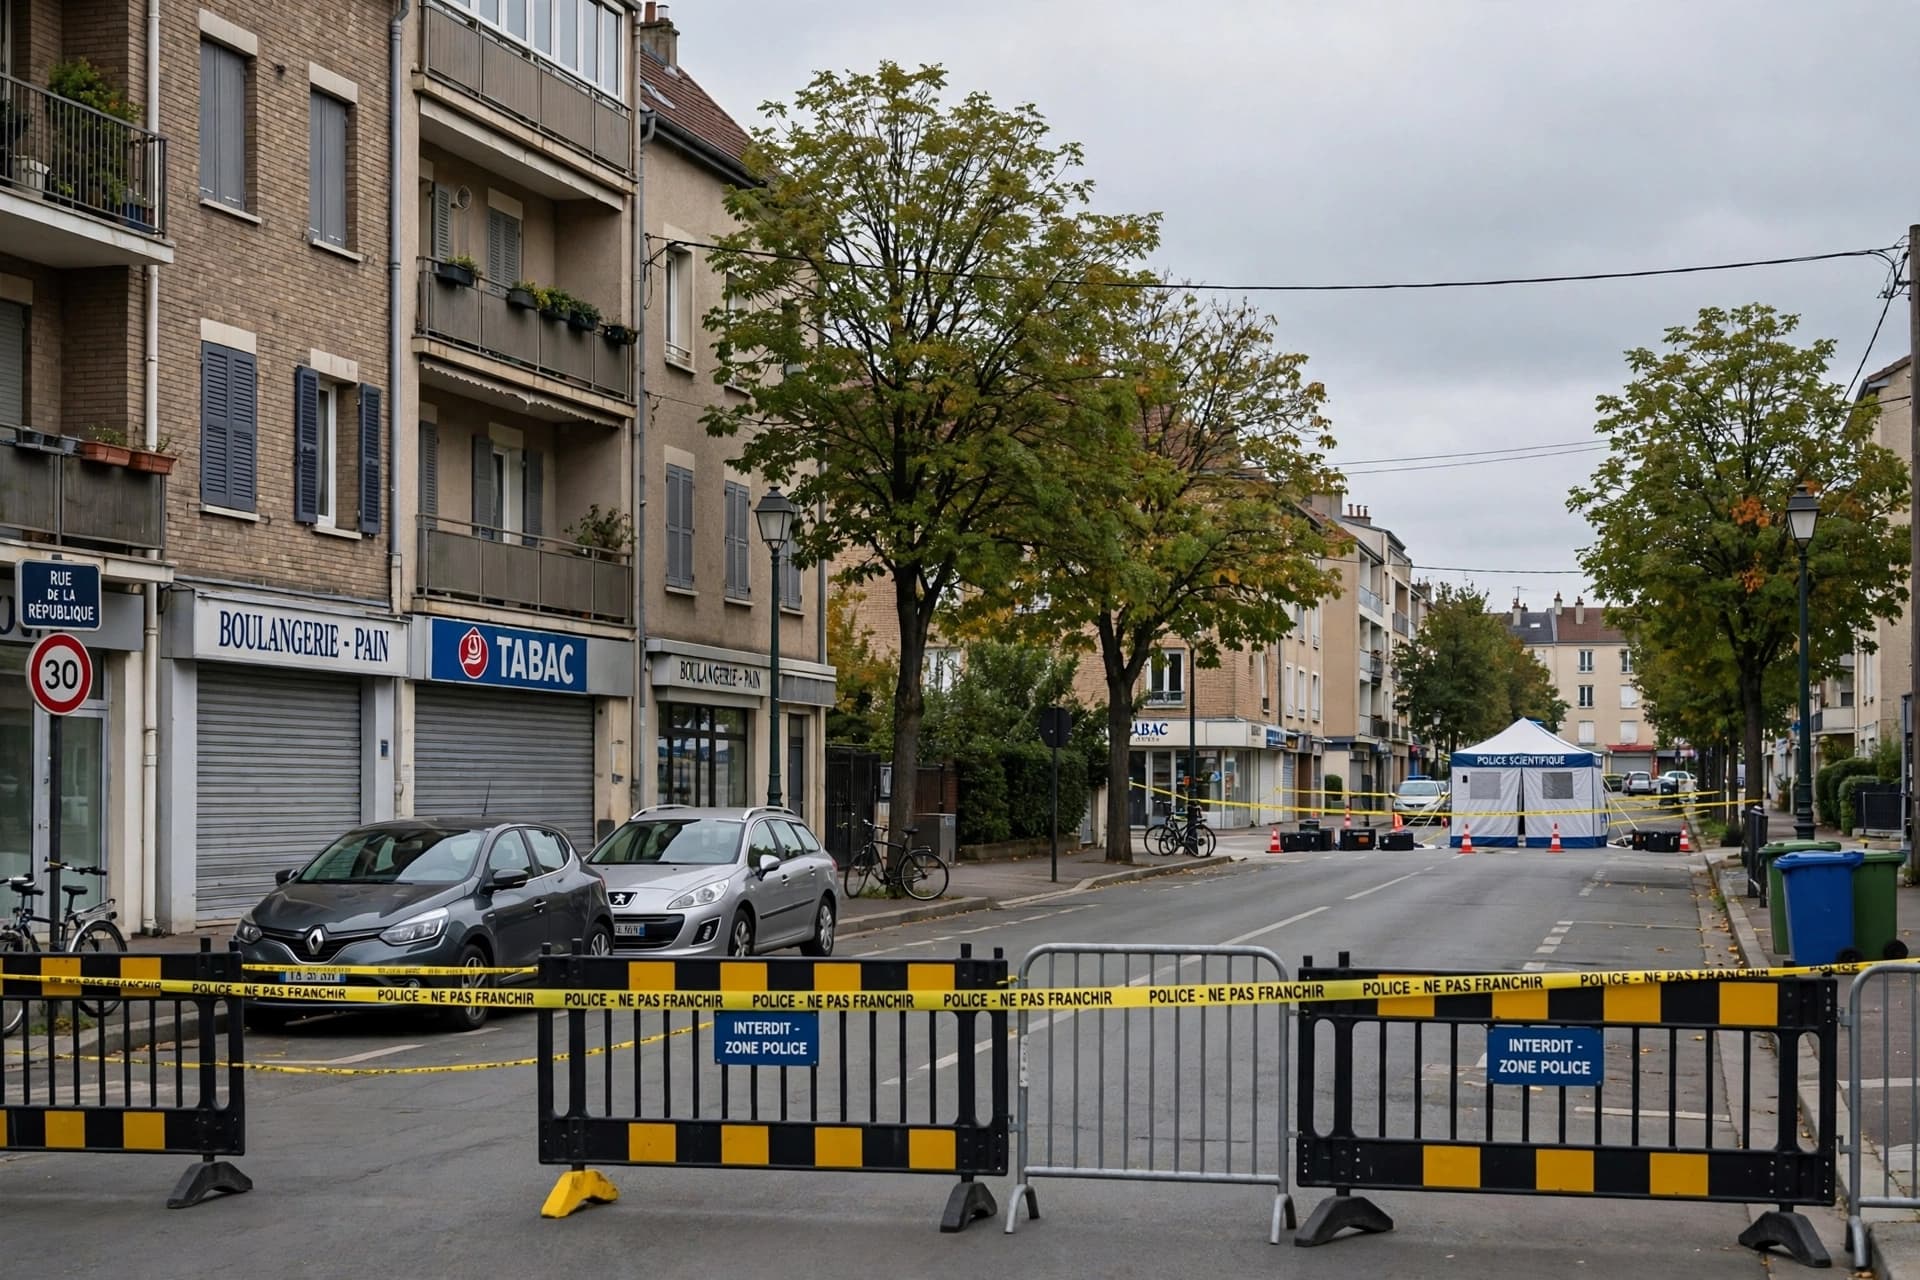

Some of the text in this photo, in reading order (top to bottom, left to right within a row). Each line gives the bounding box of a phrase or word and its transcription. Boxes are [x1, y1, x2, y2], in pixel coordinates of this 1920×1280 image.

[50, 570, 73, 586] RUE
[47, 588, 76, 601] DE LA
[28, 600, 95, 622] RÉPUBLIQUE
[218, 610, 339, 658] BOULANGERIE
[354, 627, 389, 663] PAIN
[496, 635, 575, 685] TABAC
[44, 659, 78, 689] 30
[1476, 755, 1565, 766] POLICE SCIENTIFIQUE
[1362, 981, 1410, 996] POLICE
[1423, 980, 1441, 993] NE
[1445, 978, 1471, 992] PAS
[1475, 976, 1543, 991] FRANCHIR
[1580, 973, 1629, 986] POLICE
[1644, 971, 1661, 983] NE
[1667, 970, 1693, 982] PAS
[192, 983, 232, 995] POLICE
[244, 985, 258, 996] NE
[262, 986, 284, 997] PAS
[287, 987, 346, 999] FRANCHIR
[377, 989, 419, 1001] POLICE
[430, 991, 446, 1003] NE
[450, 991, 471, 1004] PAS
[475, 991, 535, 1005] FRANCHIR
[944, 993, 988, 1007] POLICE
[1000, 992, 1016, 1006] NE
[1020, 992, 1044, 1006] PAS
[1048, 991, 1112, 1005] FRANCHIR
[1149, 989, 1195, 1003] POLICE
[1208, 987, 1226, 1001] NE
[1230, 987, 1254, 1000] PAS
[1258, 984, 1325, 1000] FRANCHIR
[564, 993, 607, 1006] POLICE
[618, 994, 634, 1007] NE
[638, 994, 660, 1007] PAS
[663, 994, 723, 1008] FRANCHIR
[752, 994, 795, 1008] POLICE
[807, 994, 823, 1008] NE
[827, 994, 849, 1008] PAS
[853, 994, 914, 1008] FRANCHIR
[734, 1021, 791, 1035] INTERDIT
[725, 1041, 807, 1055] ZONE POLICE
[1509, 1038, 1573, 1053] INTERDIT
[1499, 1060, 1591, 1075] ZONE POLICE
